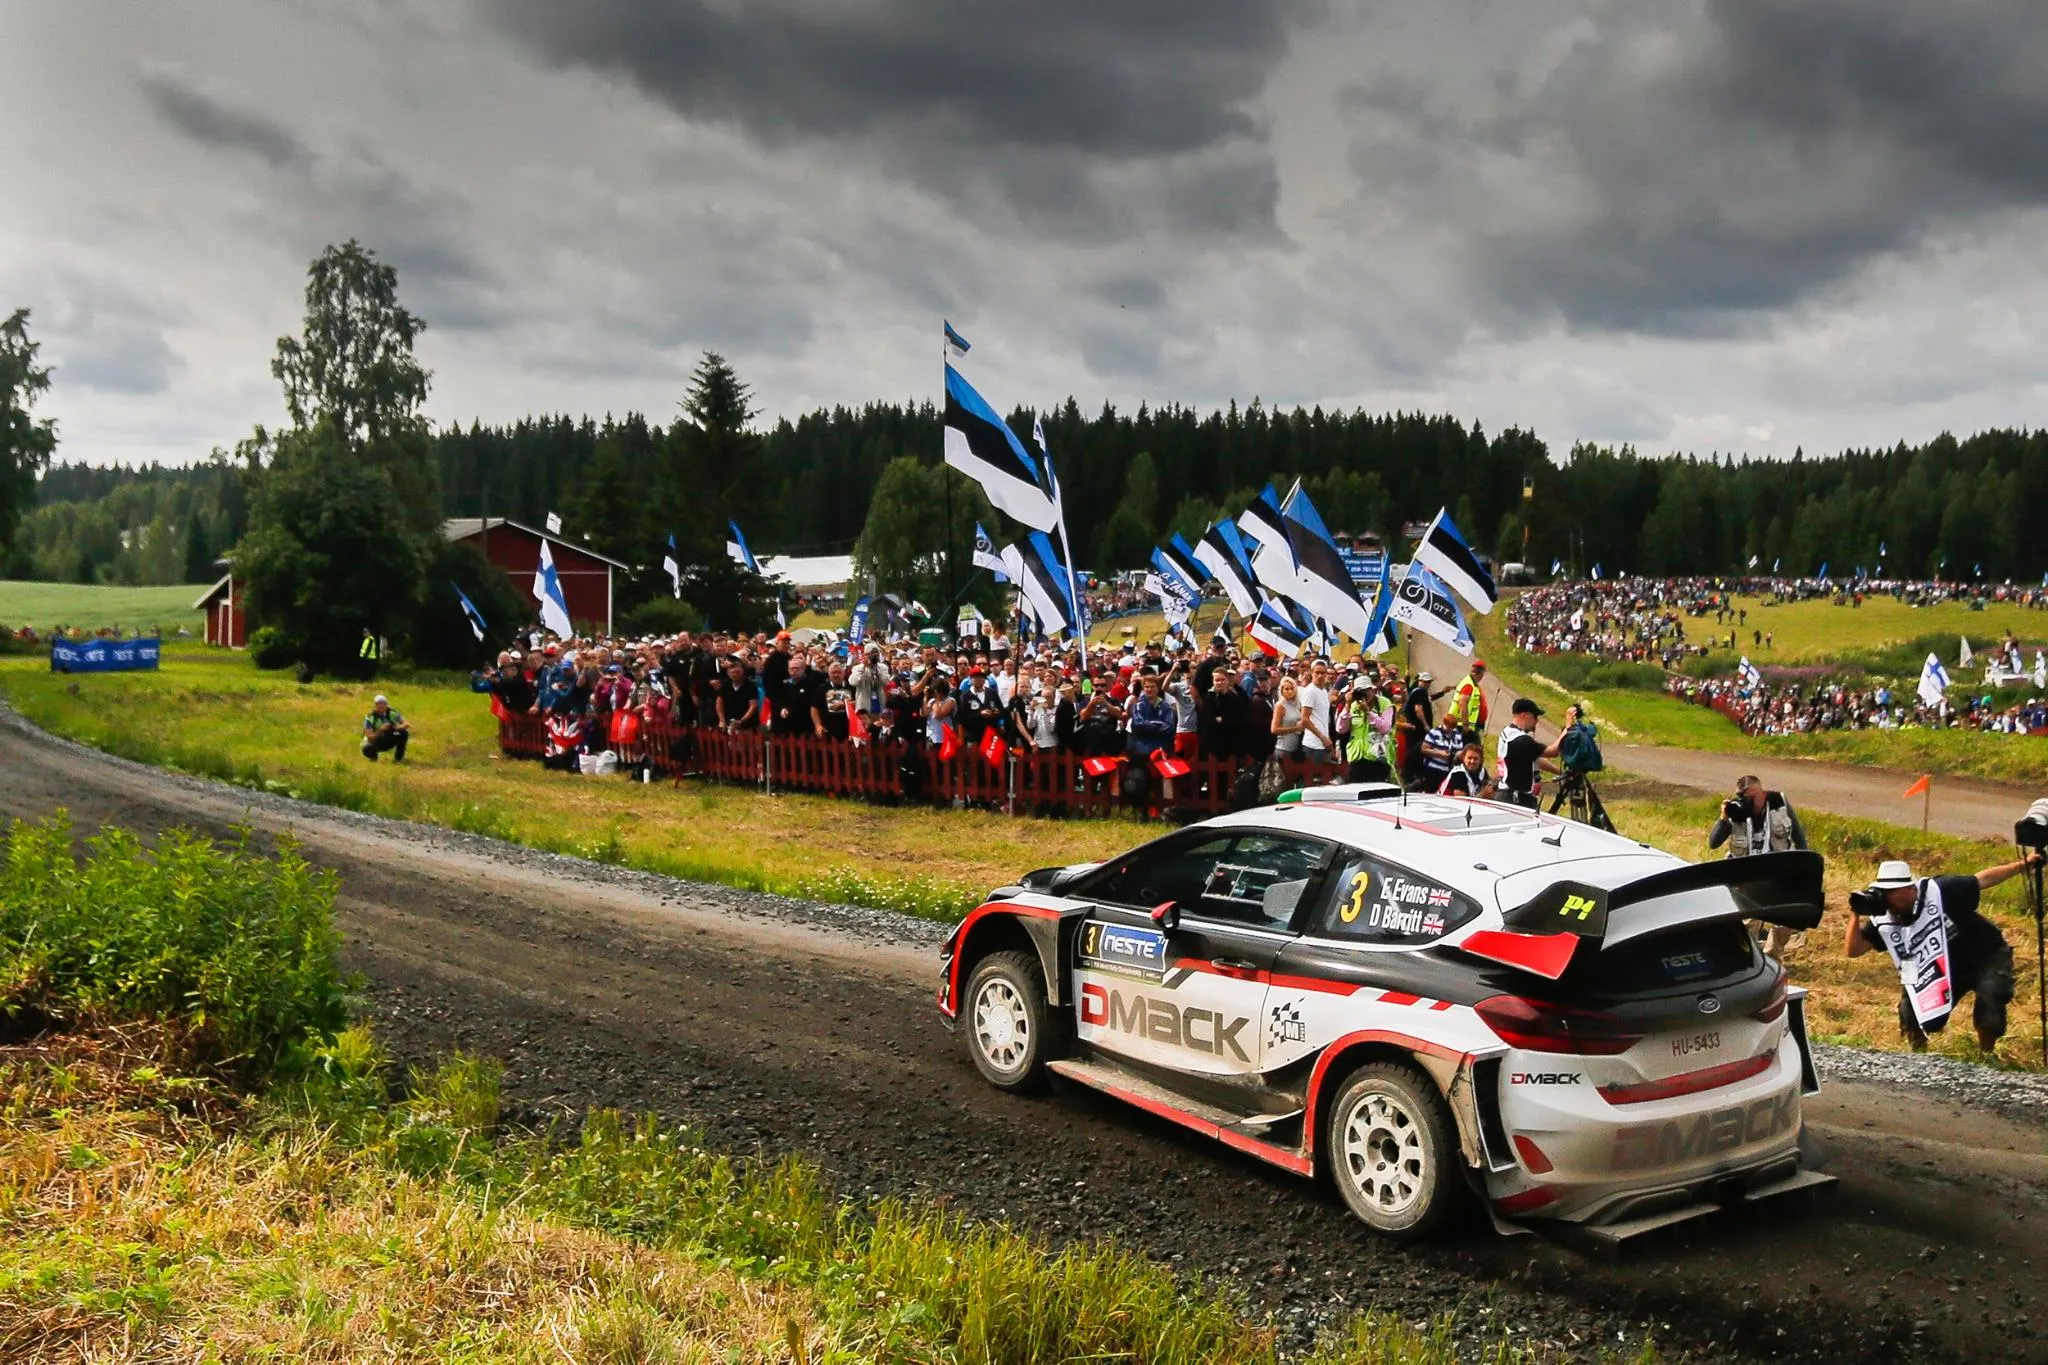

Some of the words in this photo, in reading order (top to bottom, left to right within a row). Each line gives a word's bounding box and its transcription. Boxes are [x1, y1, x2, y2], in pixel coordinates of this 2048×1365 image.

[850, 615, 860, 639] SHOP
[1340, 871, 1368, 923] 3
[1380, 877, 1394, 900] E
[1393, 878, 1429, 905] Evans
[1369, 903, 1382, 927] D
[1381, 903, 1423, 933] Barritt
[1559, 895, 1596, 921] P1
[1086, 926, 1097, 954] 3
[1103, 934, 1157, 960] NESTE
[1915, 936, 1941, 963] 219
[1081, 982, 1251, 1063] DMACK
[1671, 1031, 1721, 1057] HU-5433
[1510, 1072, 1582, 1086] DMACK
[1611, 1093, 1796, 1169] DMACK
